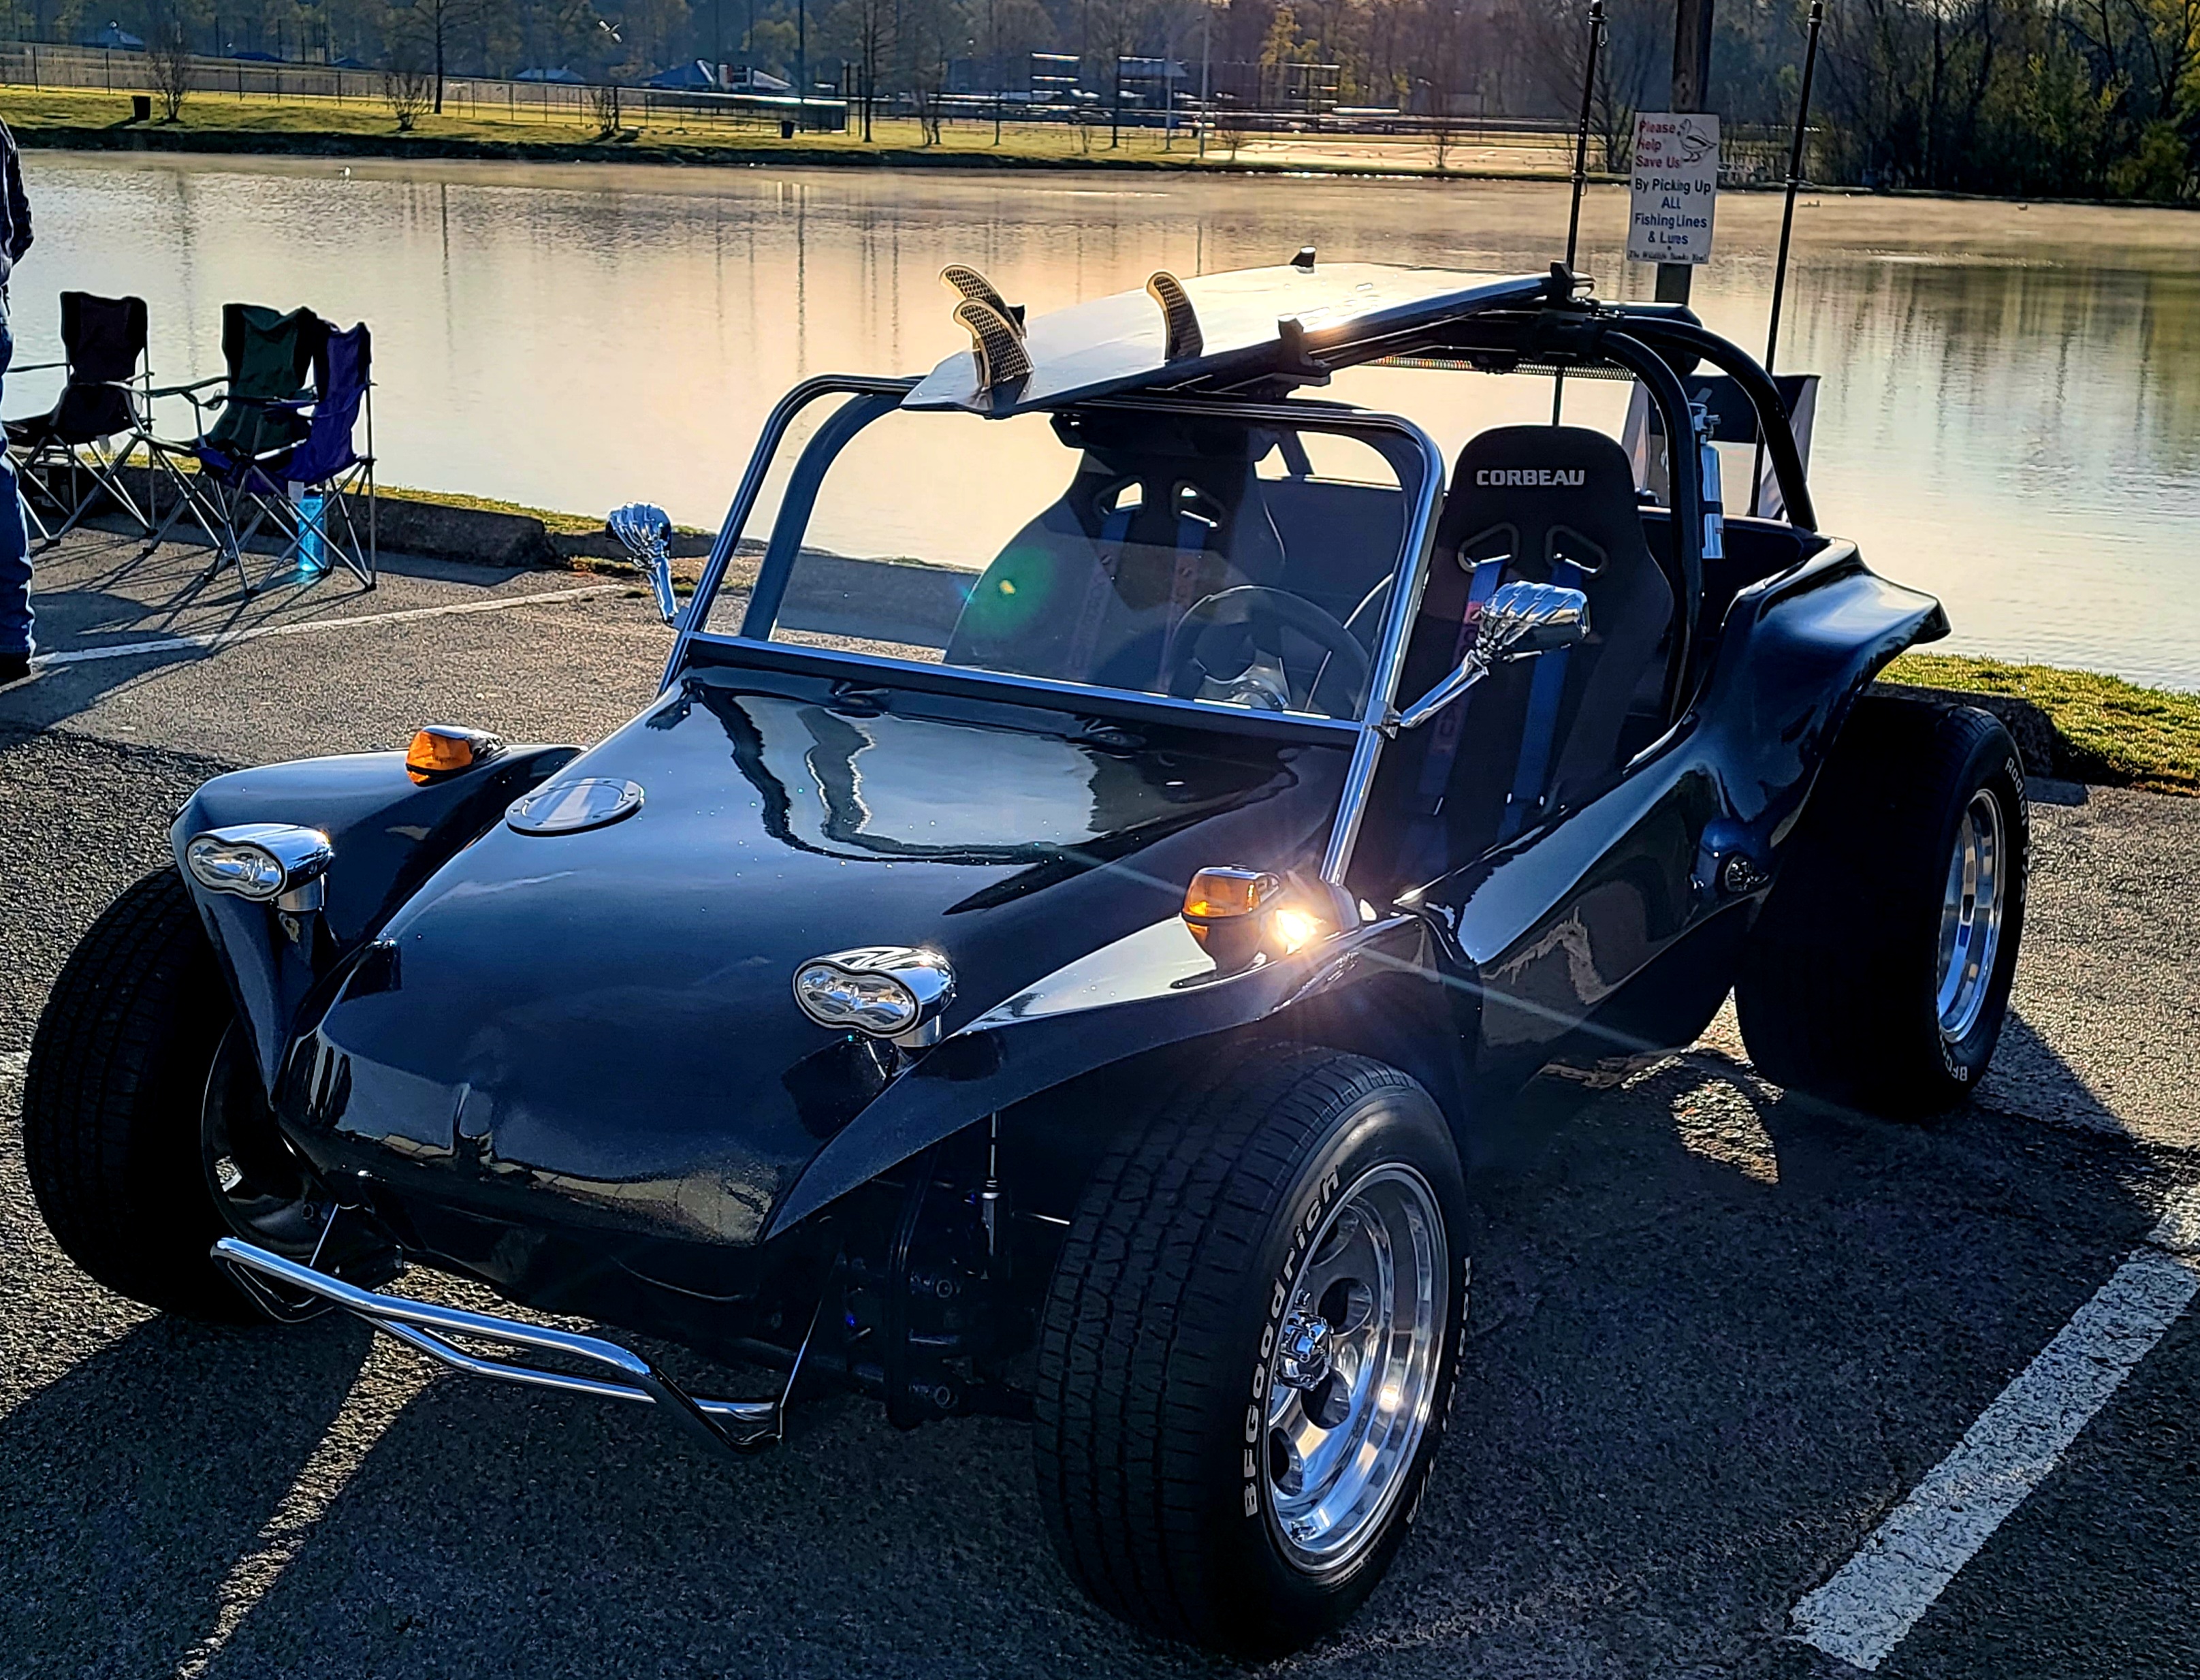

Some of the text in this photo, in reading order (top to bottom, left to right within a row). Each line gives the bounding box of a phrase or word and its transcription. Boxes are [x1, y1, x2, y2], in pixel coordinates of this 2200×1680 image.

[1638, 119, 1676, 134] Please
[1636, 137, 1662, 153] Help
[1635, 154, 1681, 169] Save Us
[1634, 178, 1649, 194] By
[1694, 179, 1712, 196] Up
[1661, 196, 1682, 210] ALL
[1634, 212, 1708, 230] Fishing Lines
[1648, 230, 1656, 243] &
[1476, 469, 1585, 486] CORBEAU
[1243, 1164, 1340, 1518] BFGoodrich
